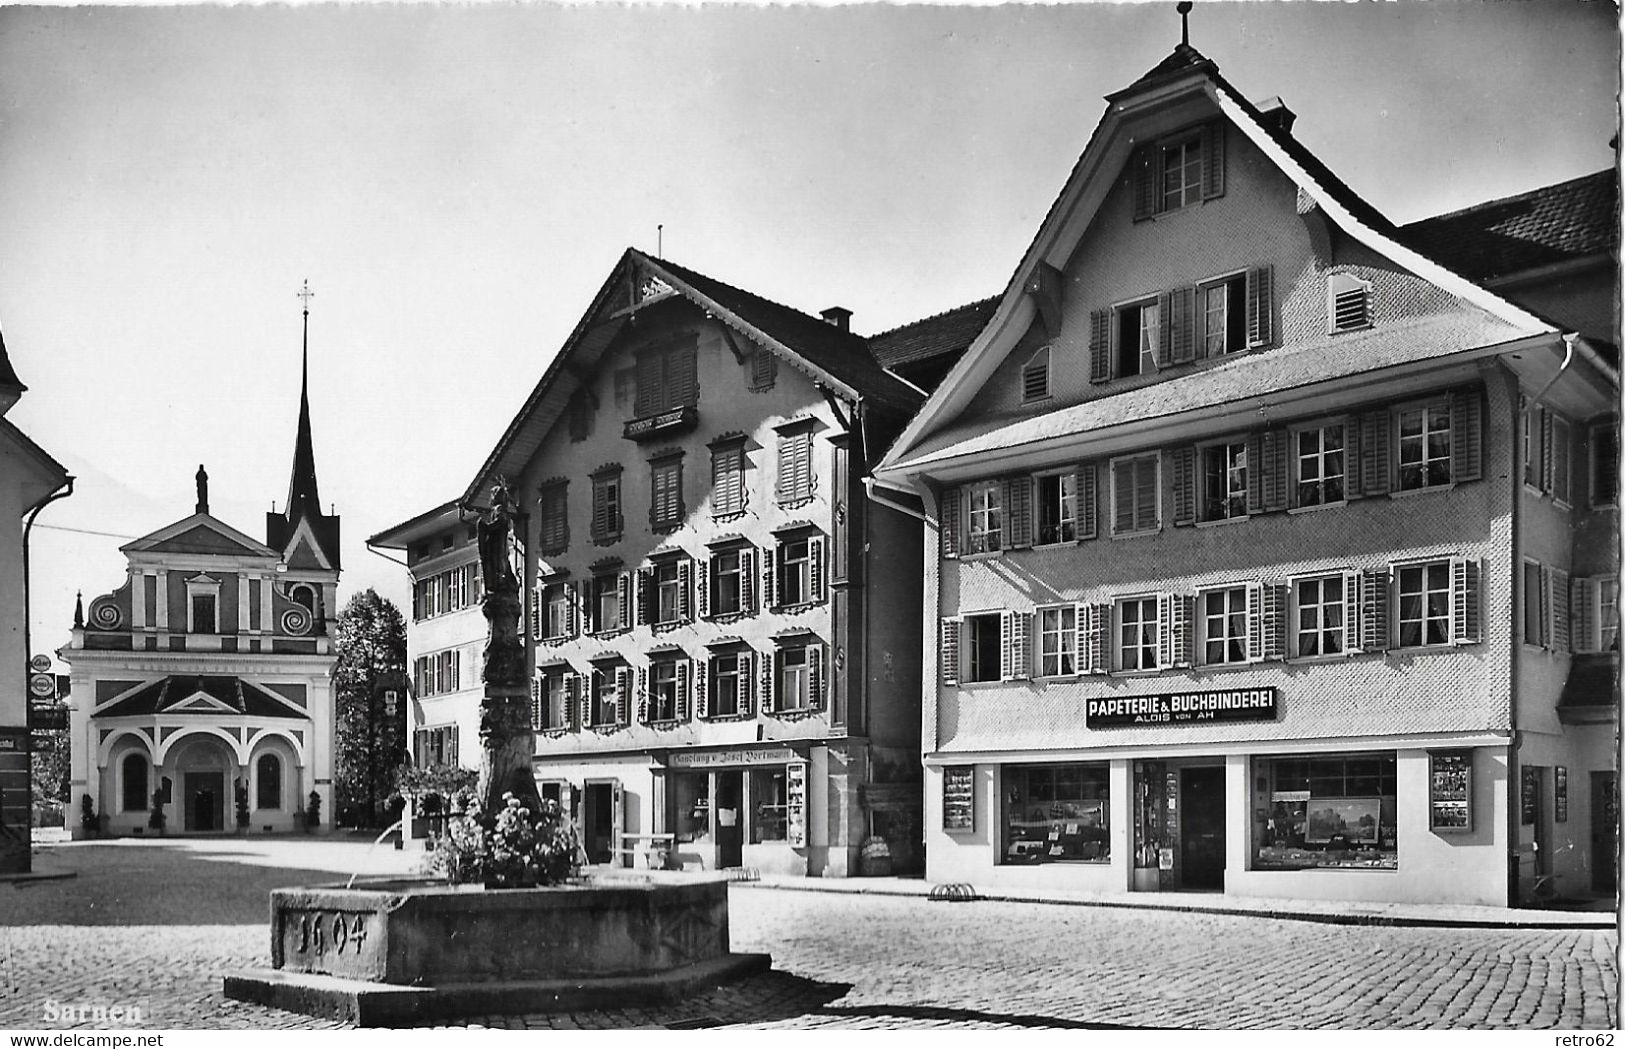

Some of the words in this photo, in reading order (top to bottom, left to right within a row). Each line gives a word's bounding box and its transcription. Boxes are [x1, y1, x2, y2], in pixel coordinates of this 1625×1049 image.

[1089, 697, 1159, 716] PAPETERIE
[1160, 701, 1170, 713] &
[1171, 690, 1273, 712] BUCHBINDEREI
[1134, 713, 1171, 723] ALOIS
[1197, 711, 1214, 719] AH
[297, 912, 368, 956] 1604
